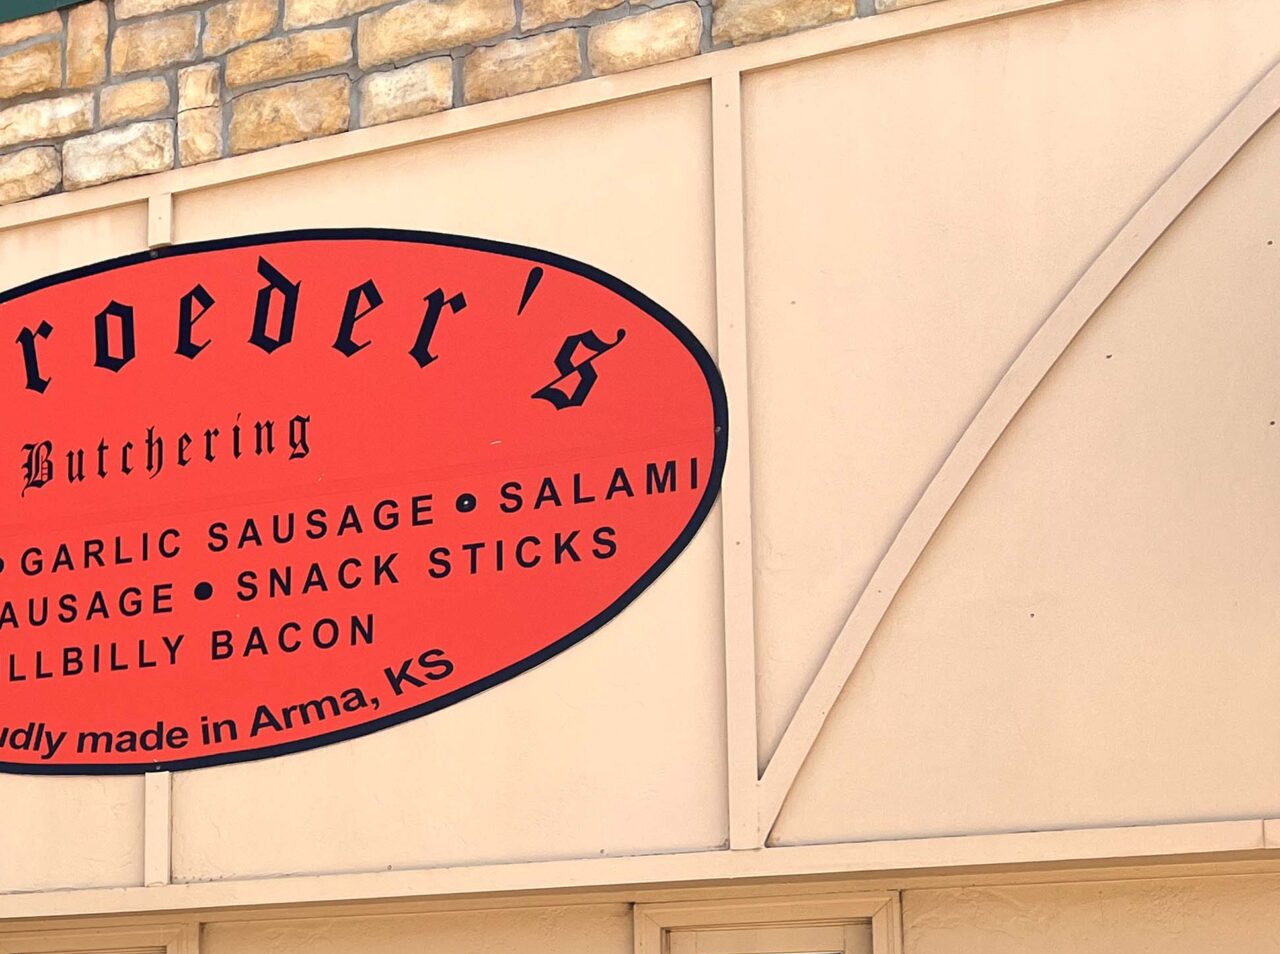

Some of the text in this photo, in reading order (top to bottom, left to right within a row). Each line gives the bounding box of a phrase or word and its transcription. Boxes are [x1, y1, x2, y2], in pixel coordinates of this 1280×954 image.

[20, 411, 312, 498] Butchering
[20, 528, 182, 577] GARLIC
[207, 494, 434, 553] SAUSAGE
[499, 457, 699, 515] SALAMI
[236, 552, 400, 602] SNACK
[427, 526, 618, 580] STICKS
[211, 613, 375, 662] BACON
[76, 720, 189, 754] made
[200, 713, 238, 746] in
[249, 687, 381, 737] Arma,
[382, 648, 455, 696] KS
